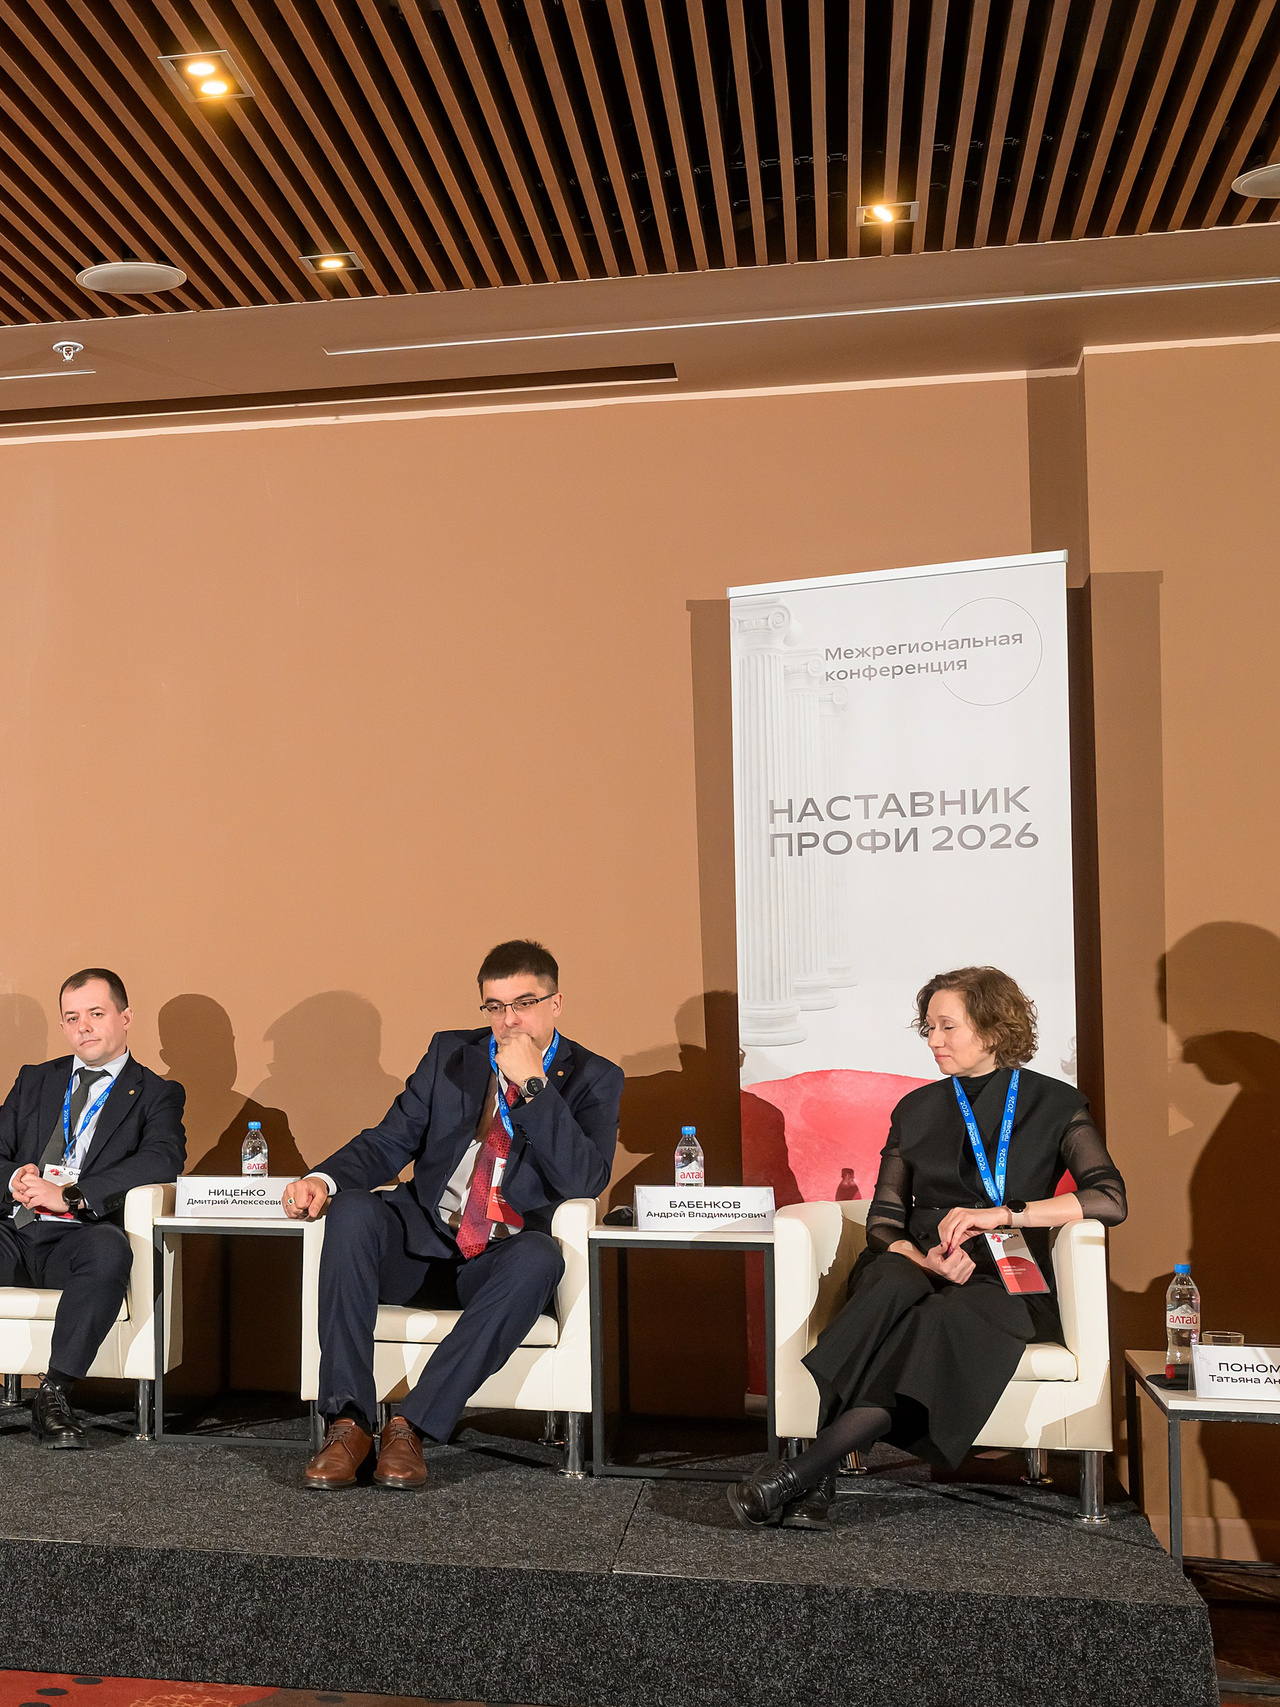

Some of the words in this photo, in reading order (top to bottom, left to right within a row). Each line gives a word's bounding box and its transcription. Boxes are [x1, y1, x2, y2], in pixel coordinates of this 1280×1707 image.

[824, 632, 1024, 661] Межрегиональная
[825, 658, 968, 682] конференция
[768, 786, 1031, 824] НАСТАВНИК
[769, 827, 919, 858] ПРОФИ
[931, 822, 1039, 852] 2026
[960, 1100, 970, 1117] 2026
[1007, 1096, 1015, 1113] 2026
[976, 1152, 987, 1171] 2026
[998, 1148, 1006, 1167] 2026
[187, 1198, 229, 1206] Дмитрий
[231, 1198, 281, 1206] Алексееви
[208, 1189, 266, 1198] НИЦЕНКО
[669, 1200, 741, 1209] БАБЕНКОВ
[646, 1210, 686, 1219] Андрей
[688, 1211, 767, 1219] Владимирович
[1169, 1314, 1198, 1325] алтай
[1209, 1374, 1261, 1384] Татьяна
